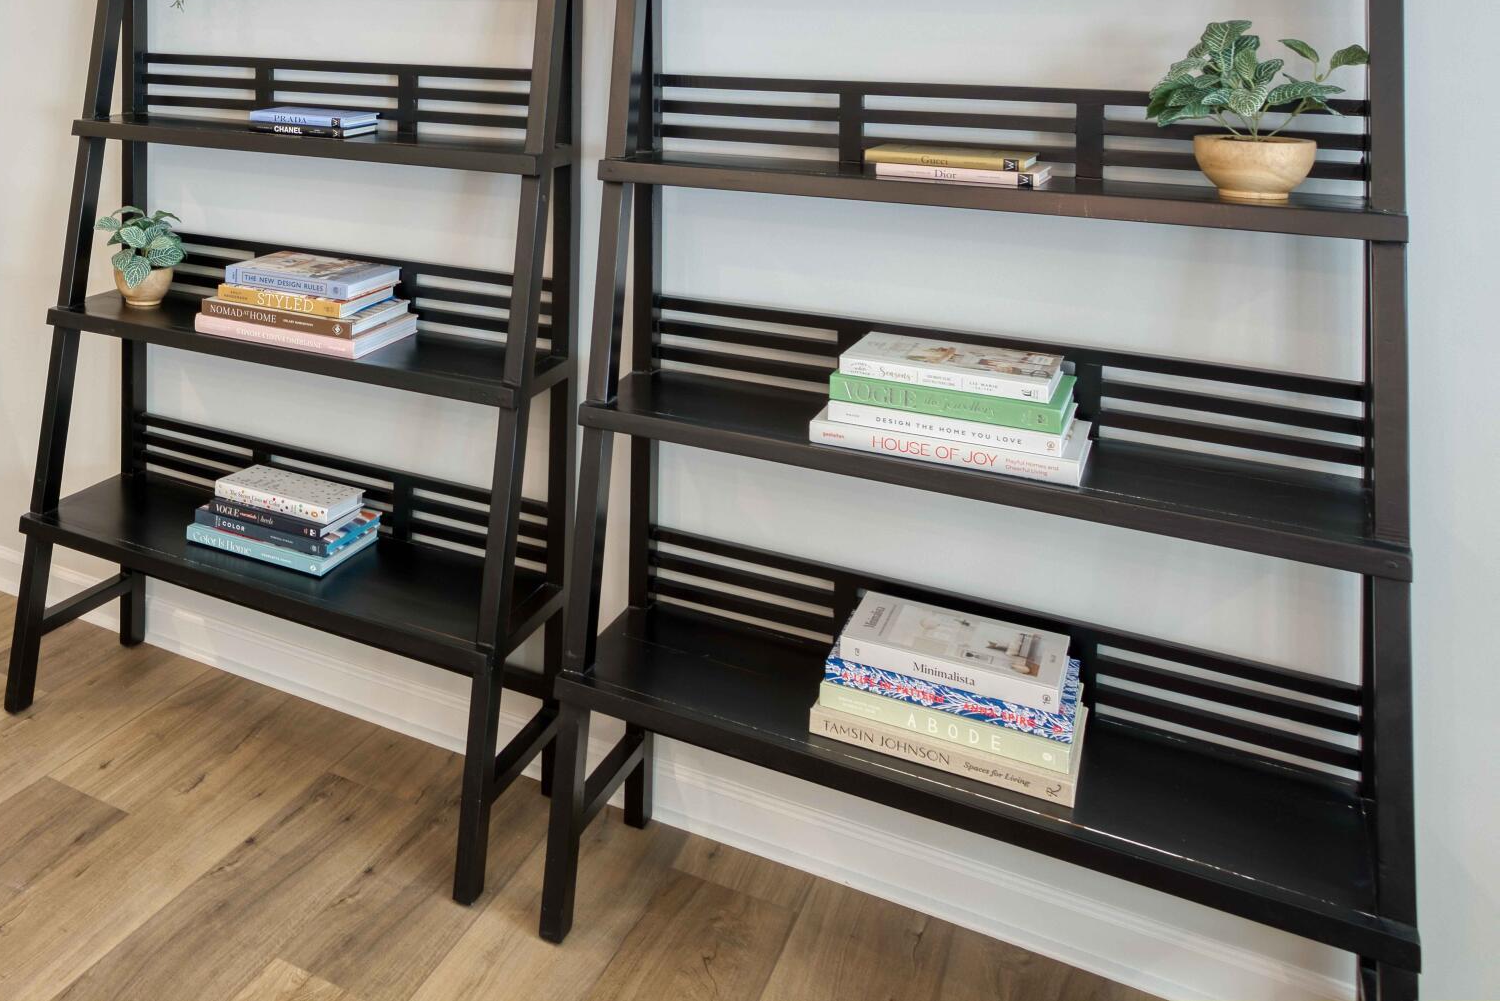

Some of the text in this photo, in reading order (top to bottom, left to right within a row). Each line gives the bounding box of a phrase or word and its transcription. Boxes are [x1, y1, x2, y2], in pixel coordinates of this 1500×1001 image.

[274, 115, 307, 124] PRADA
[274, 125, 303, 134] CHANEL
[921, 155, 949, 166] Gucci
[934, 169, 957, 179] Dior
[244, 274, 257, 282] THE
[277, 279, 302, 289] DESIGN
[303, 283, 324, 292] RULES
[257, 293, 314, 312] STYLED
[209, 304, 243, 317] NOMAD
[249, 312, 277, 324] HOME
[844, 381, 917, 409] VOGUE
[875, 416, 1023, 445] DESIGN THE HOME YOU LOVE
[872, 436, 998, 467] HOUSE OF JOY
[215, 503, 240, 518] VOGUE
[222, 520, 245, 532] COLOR
[193, 532, 217, 546] Color
[226, 539, 252, 554] Home
[912, 661, 976, 686] Minimalista
[907, 711, 1002, 751] ABODE
[823, 719, 950, 765] TAMSIN JOHNSON
[963, 761, 1031, 788] Spaces for Living
